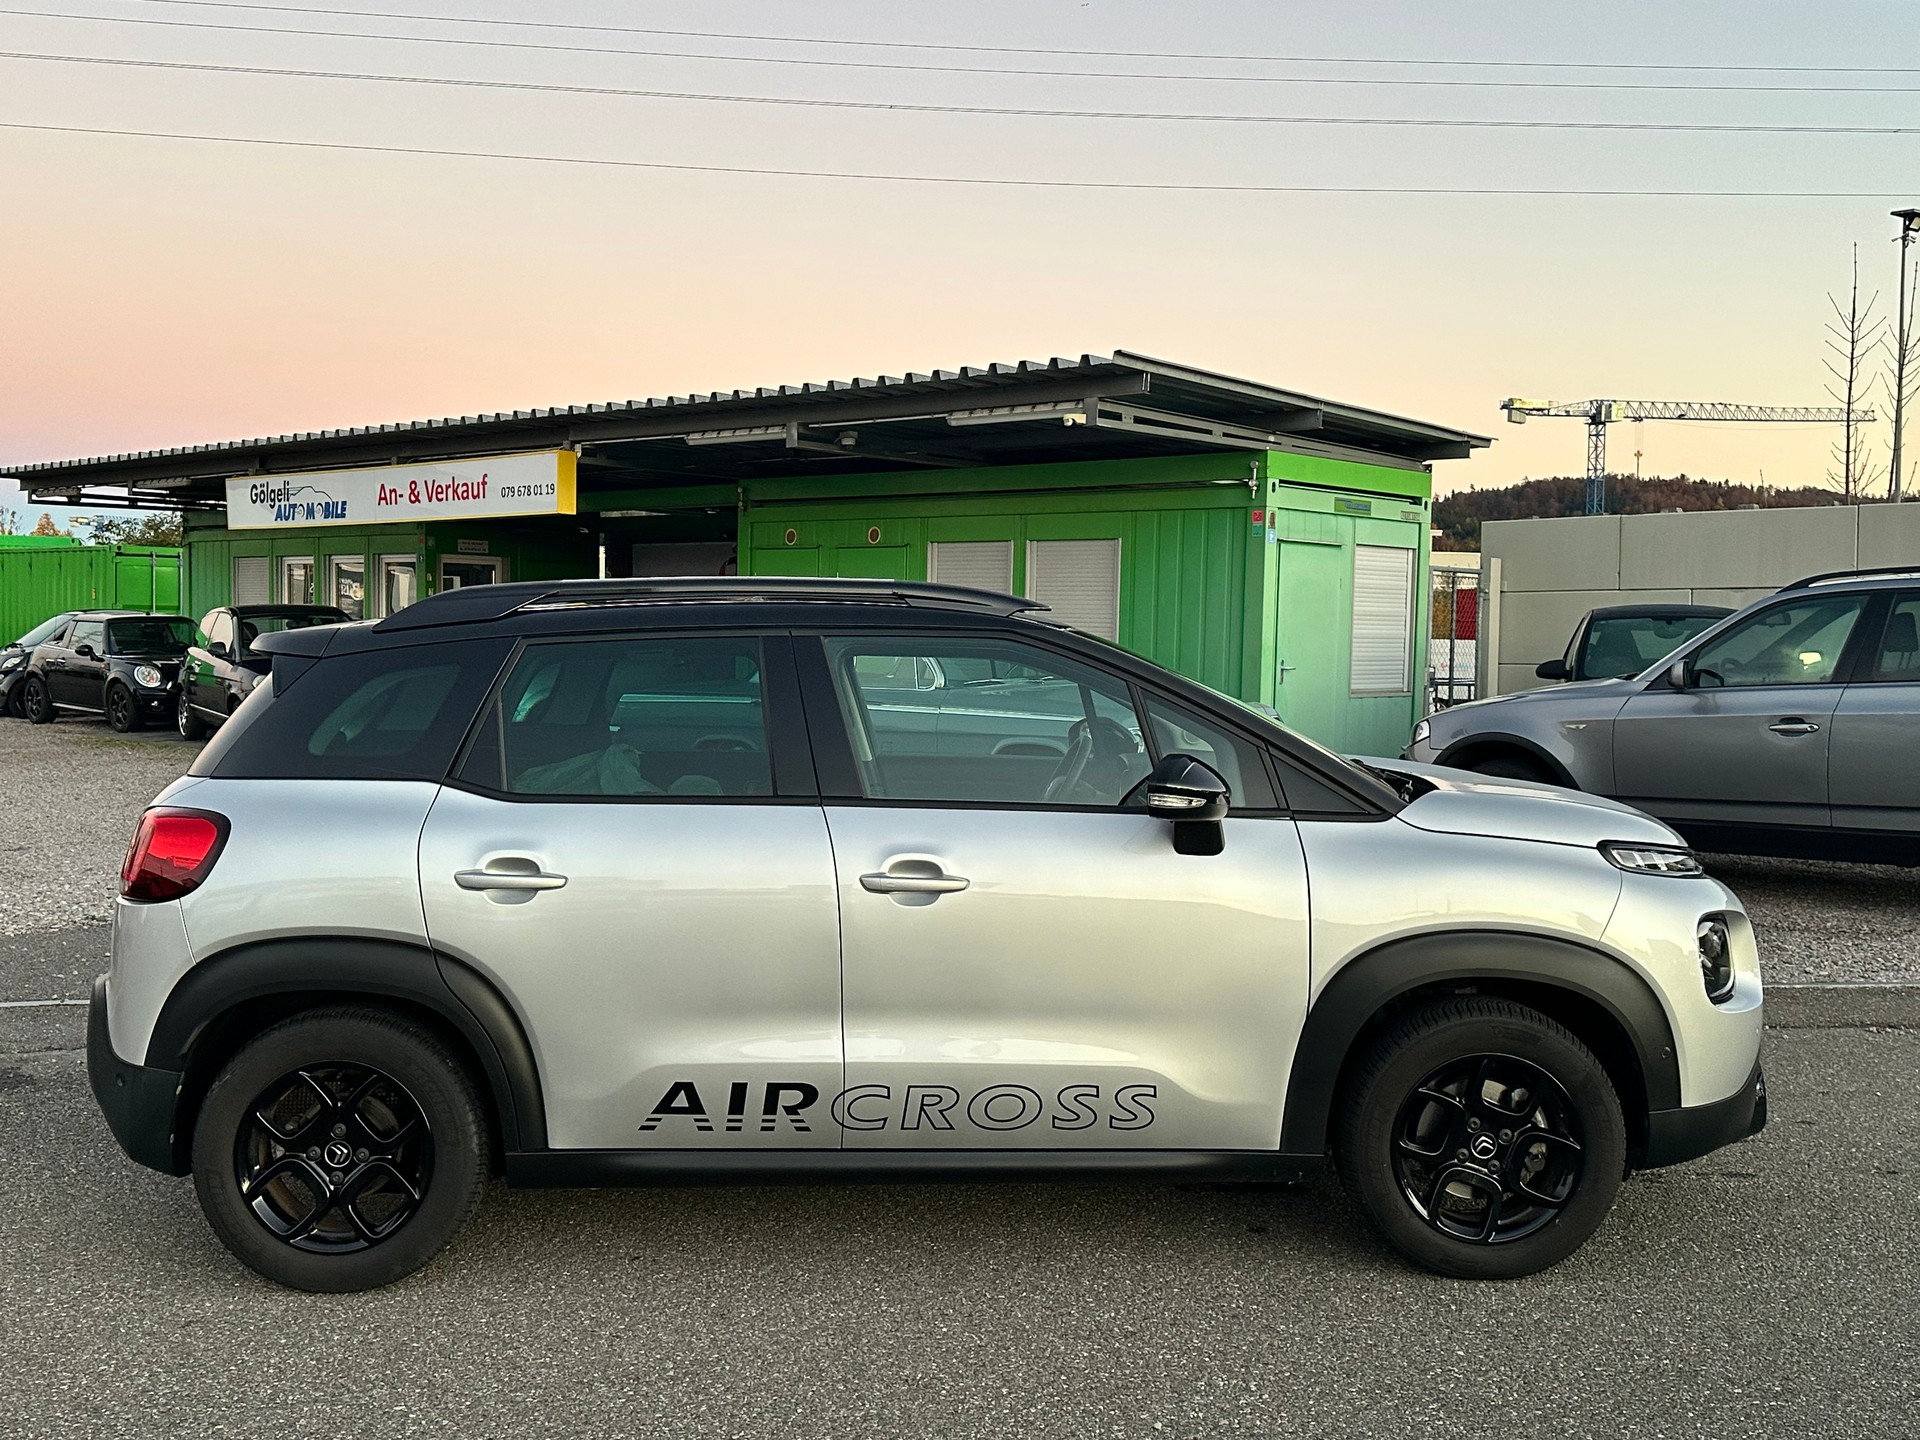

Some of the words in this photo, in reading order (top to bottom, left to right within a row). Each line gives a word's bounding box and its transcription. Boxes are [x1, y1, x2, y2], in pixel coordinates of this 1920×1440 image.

[250, 480, 290, 509] Gölgeli
[378, 483, 404, 506] An-
[408, 480, 421, 504] &
[423, 473, 488, 503] Verkauf
[501, 486, 515, 498] 079
[517, 485, 532, 497] 678
[533, 484, 543, 496] 01
[545, 483, 555, 495] 19
[275, 500, 347, 521] AUTOMOBILE
[637, 1081, 1158, 1133] AIRCROSS
